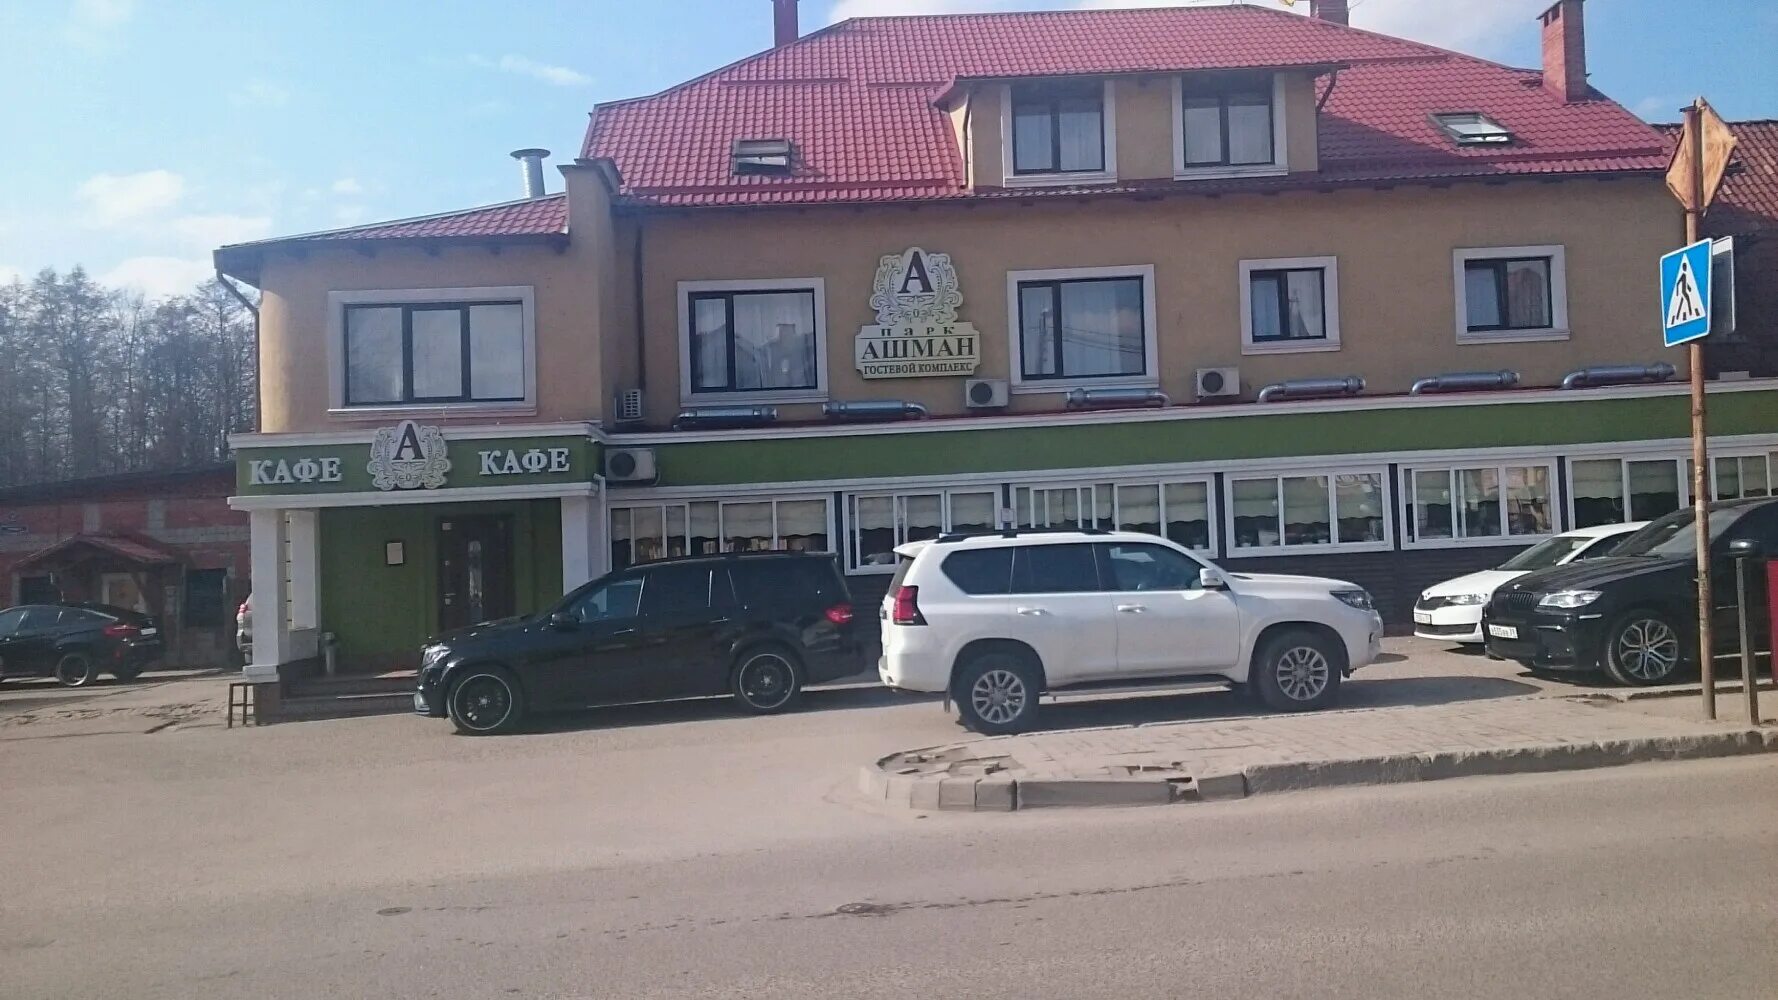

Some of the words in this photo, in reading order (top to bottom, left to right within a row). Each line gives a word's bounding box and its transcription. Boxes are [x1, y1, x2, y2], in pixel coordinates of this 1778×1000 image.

[862, 337, 974, 360] АШМАН
[864, 362, 916, 375] ГОСТЕВОЙ
[918, 361, 973, 373] КОМПЛЕКС
[249, 457, 343, 486] КАФЕ
[478, 448, 570, 475] КАФЕ
